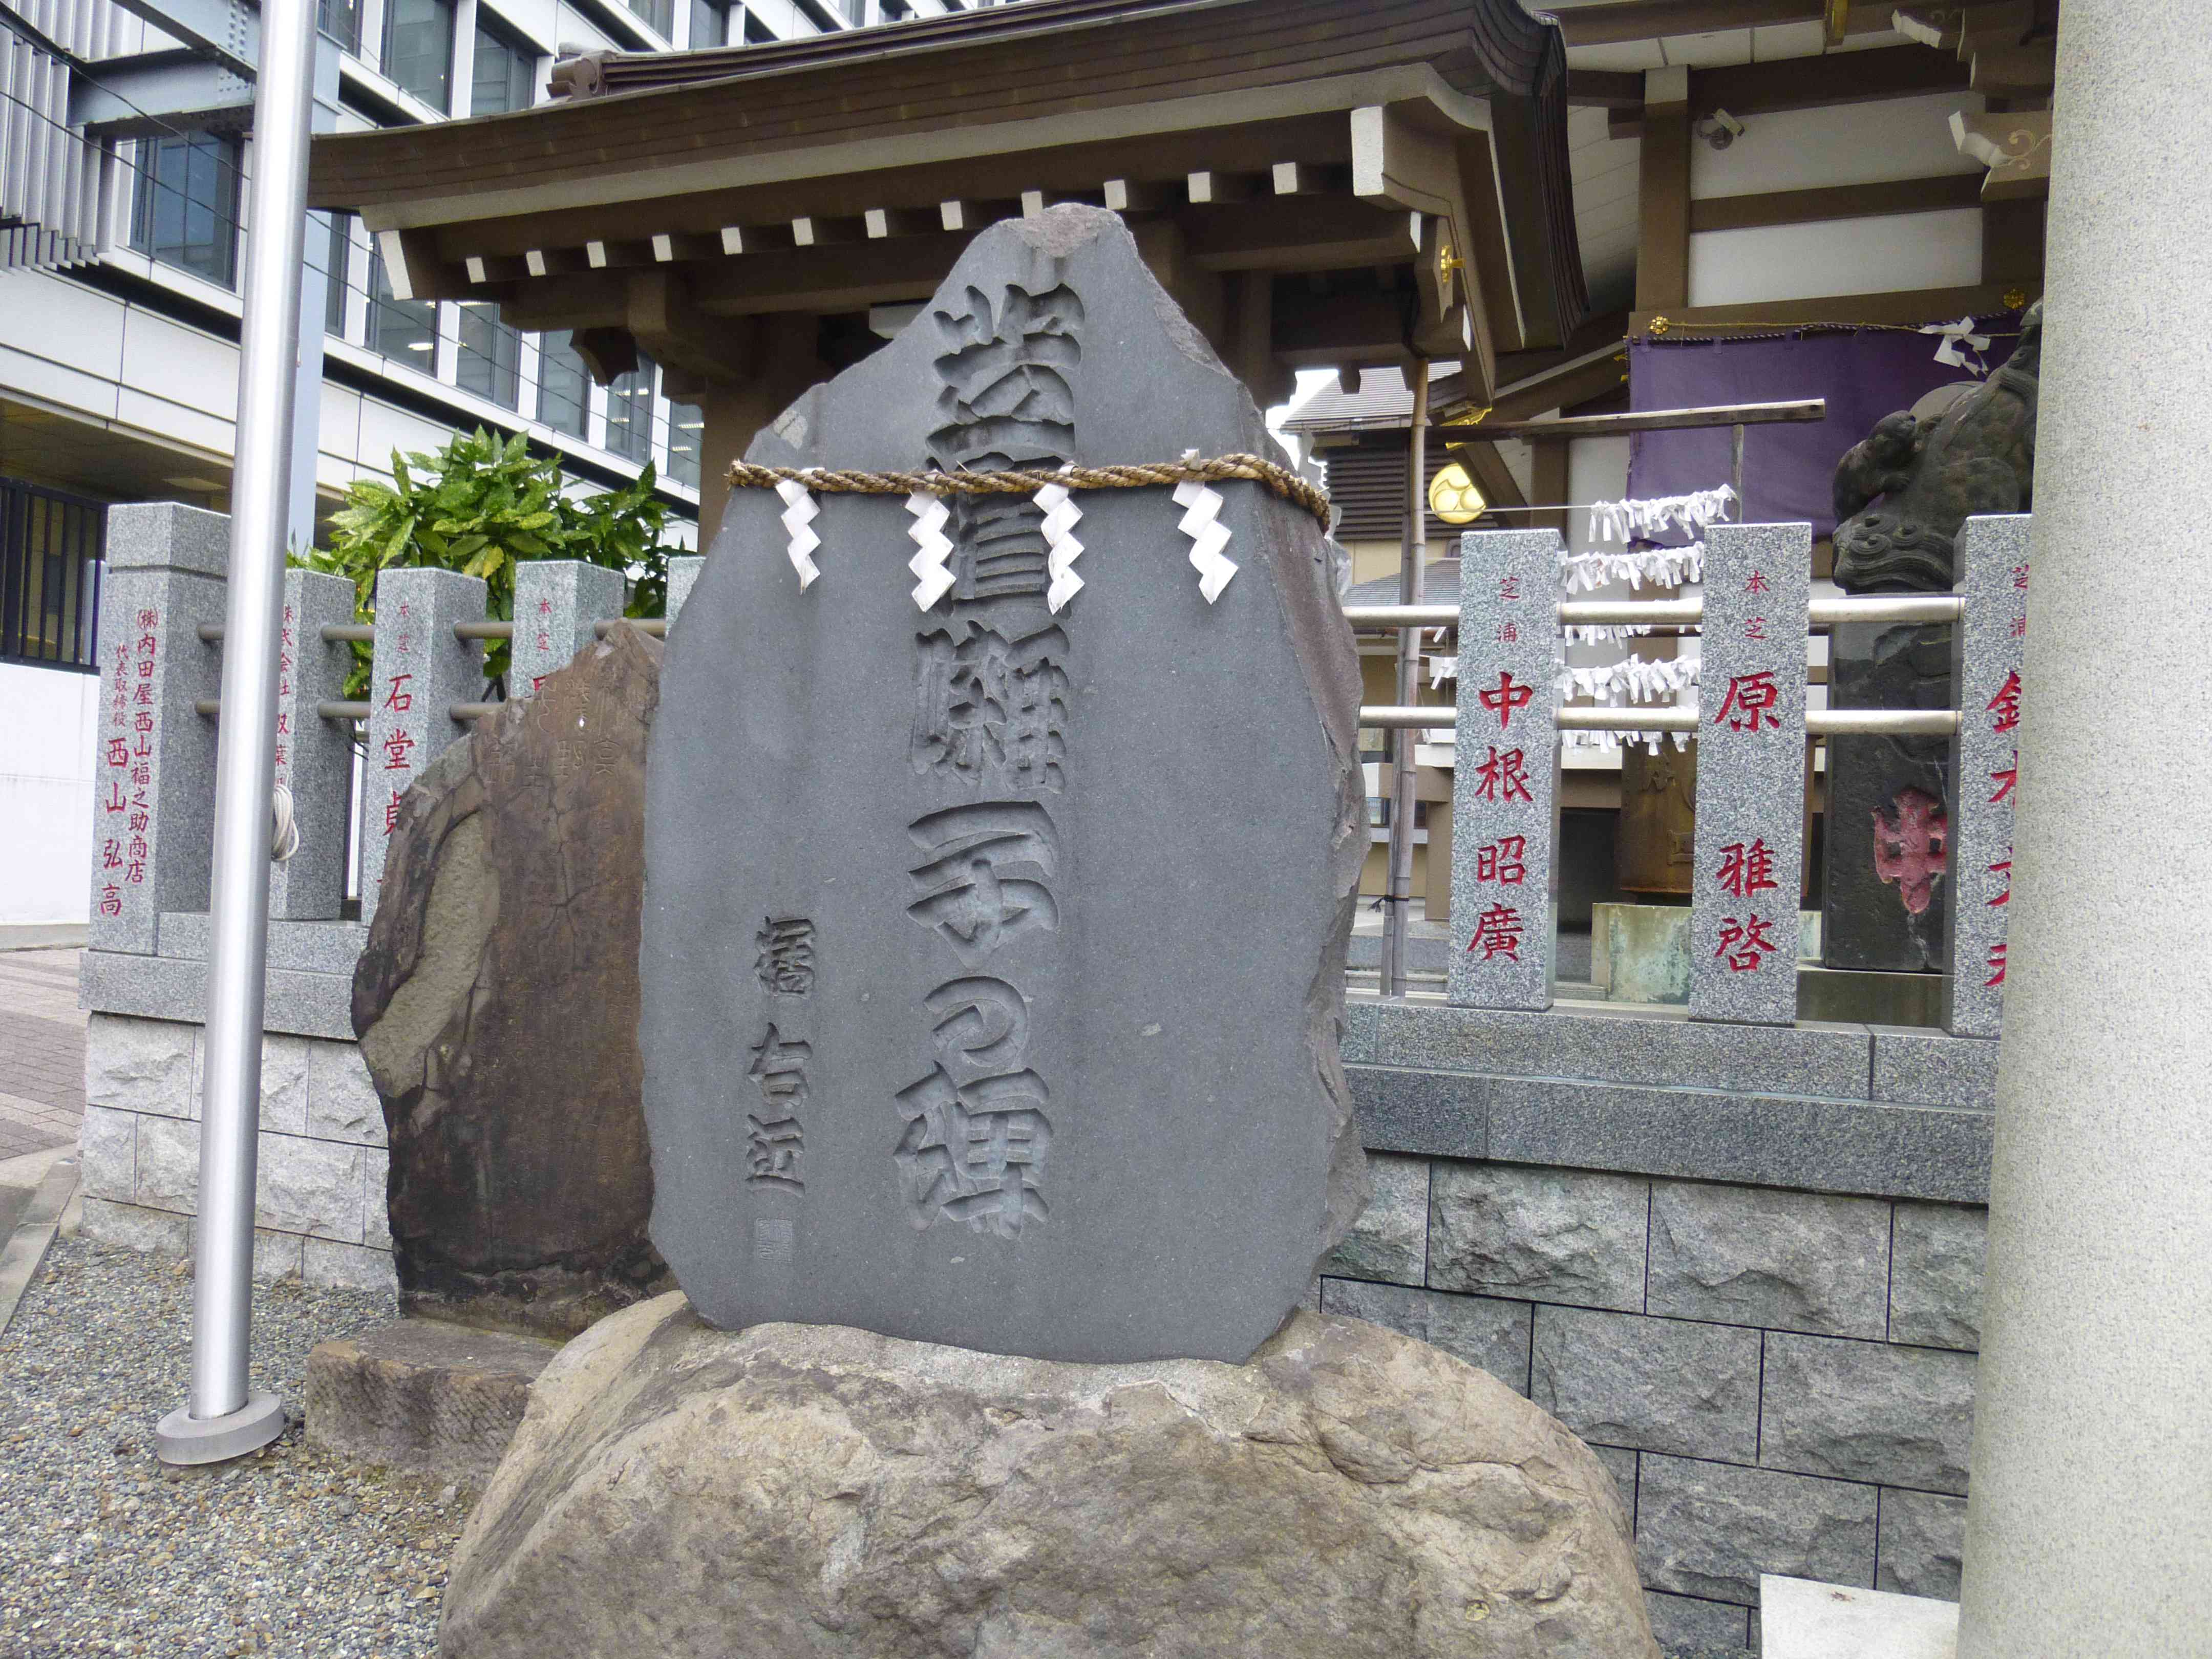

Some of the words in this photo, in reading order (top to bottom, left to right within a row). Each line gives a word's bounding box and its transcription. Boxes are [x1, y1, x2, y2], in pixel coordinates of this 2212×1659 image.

[537, 598, 552, 651] 本芝
[1497, 576, 1520, 643] 芝浦
[1744, 570, 1770, 639] 本芝
[376, 674, 415, 883] 石堂貞
[1465, 672, 1534, 962] 中根昭廣
